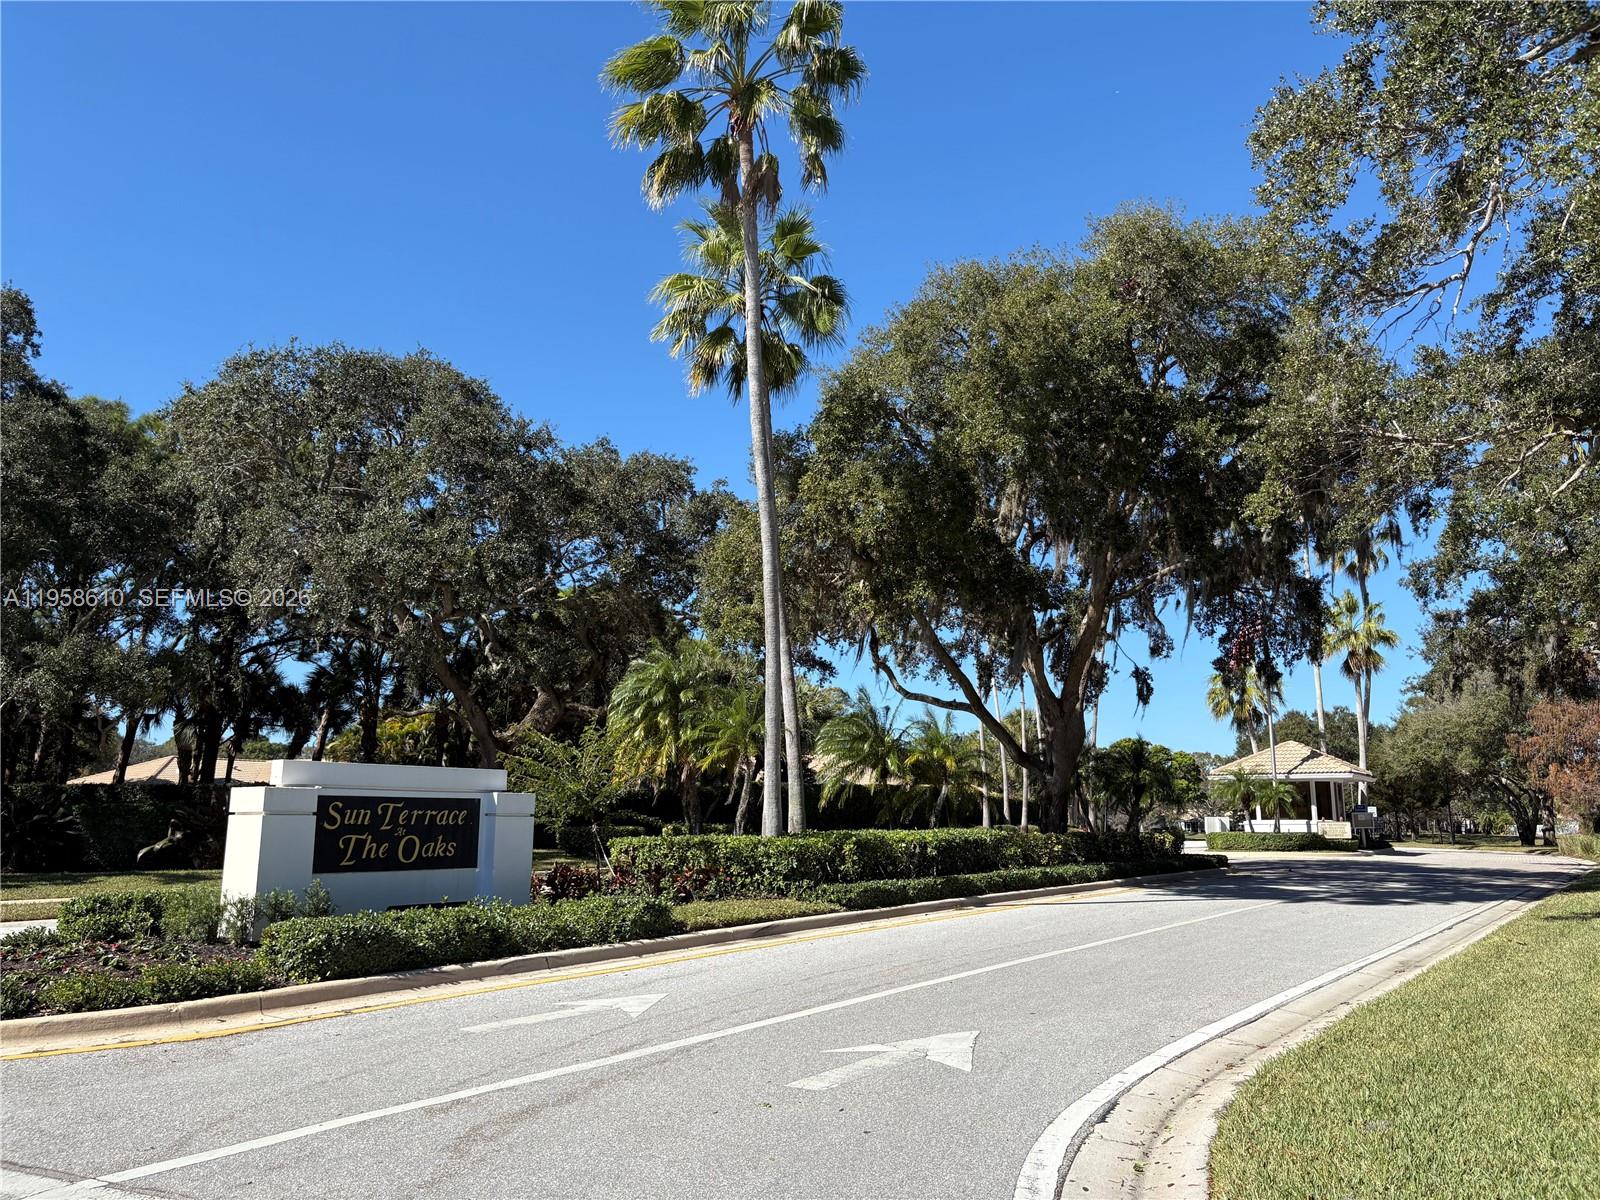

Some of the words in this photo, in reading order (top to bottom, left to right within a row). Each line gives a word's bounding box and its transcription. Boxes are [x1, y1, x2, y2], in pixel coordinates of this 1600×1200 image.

[323, 801, 371, 830] Sun
[377, 802, 467, 831] Terrace
[339, 832, 389, 866] The
[398, 835, 457, 864] Oaks
